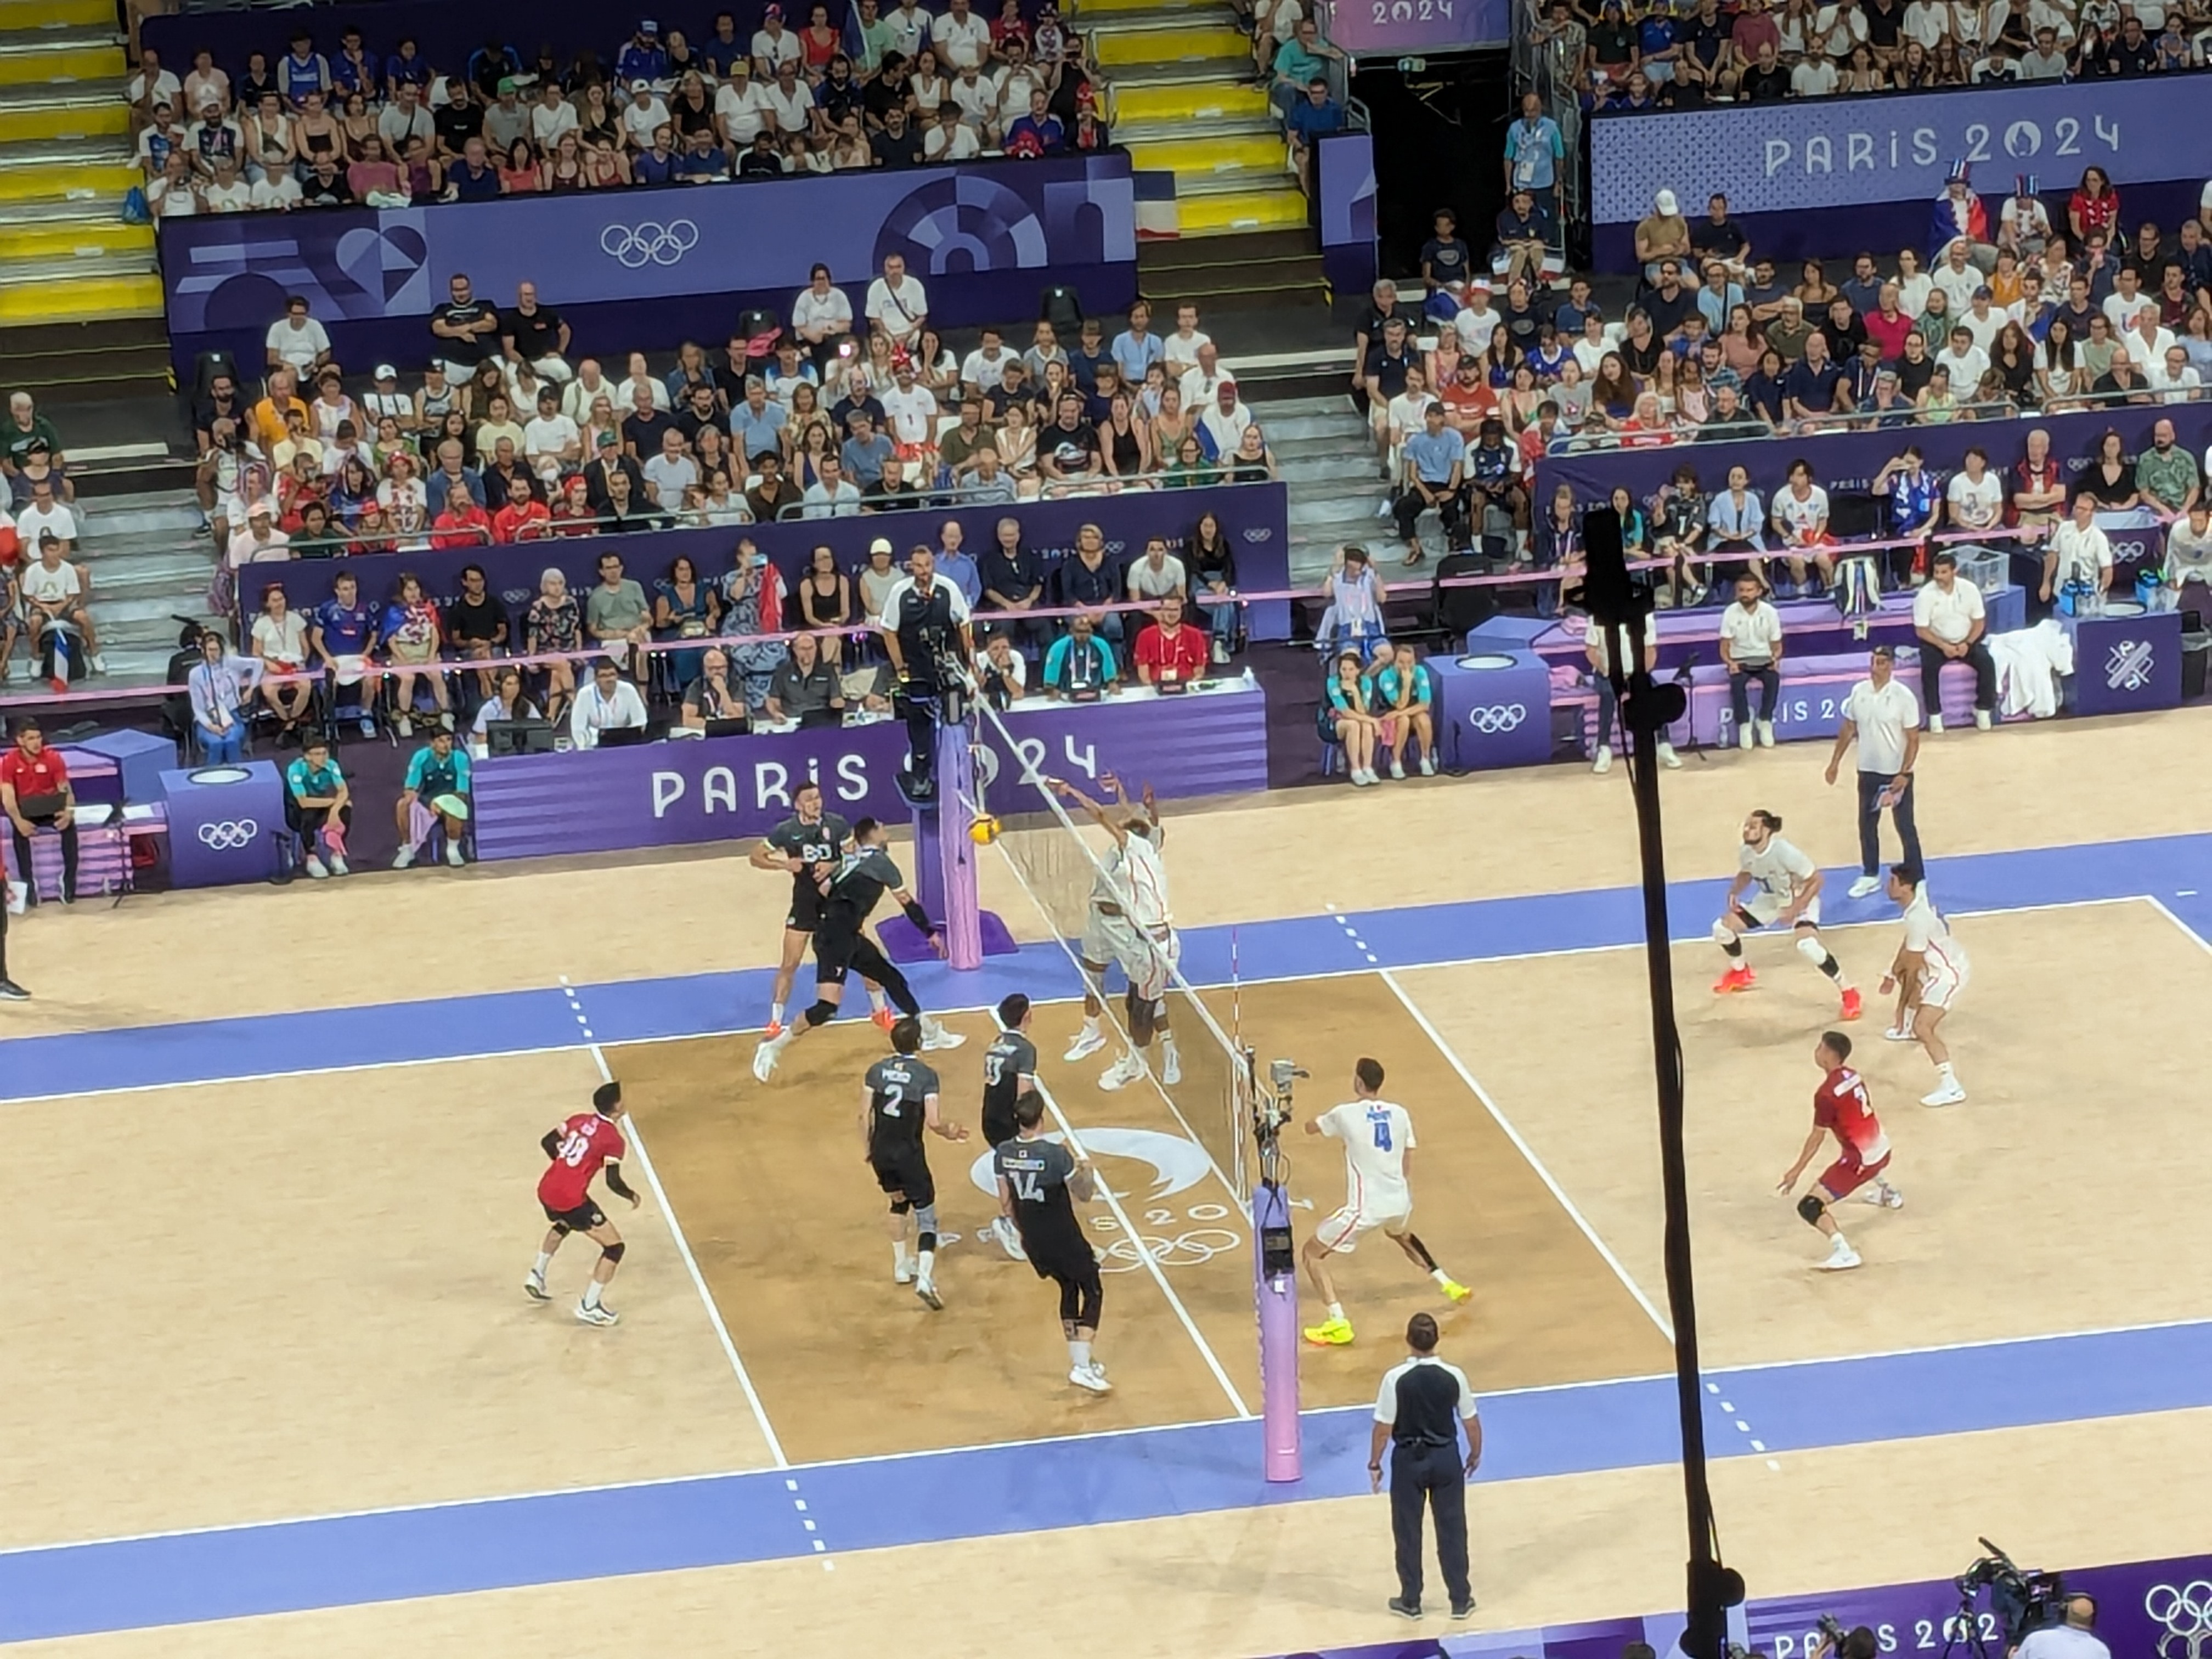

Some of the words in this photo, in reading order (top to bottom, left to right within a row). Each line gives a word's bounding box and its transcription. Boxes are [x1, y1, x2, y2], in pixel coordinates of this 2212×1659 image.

[1372, 0, 1452, 24] 2024
[1966, 115, 2119, 162] 2024
[883, 1084, 903, 1118] 2
[1374, 1122, 1392, 1152] 4
[1008, 1171, 1045, 1203] 14
